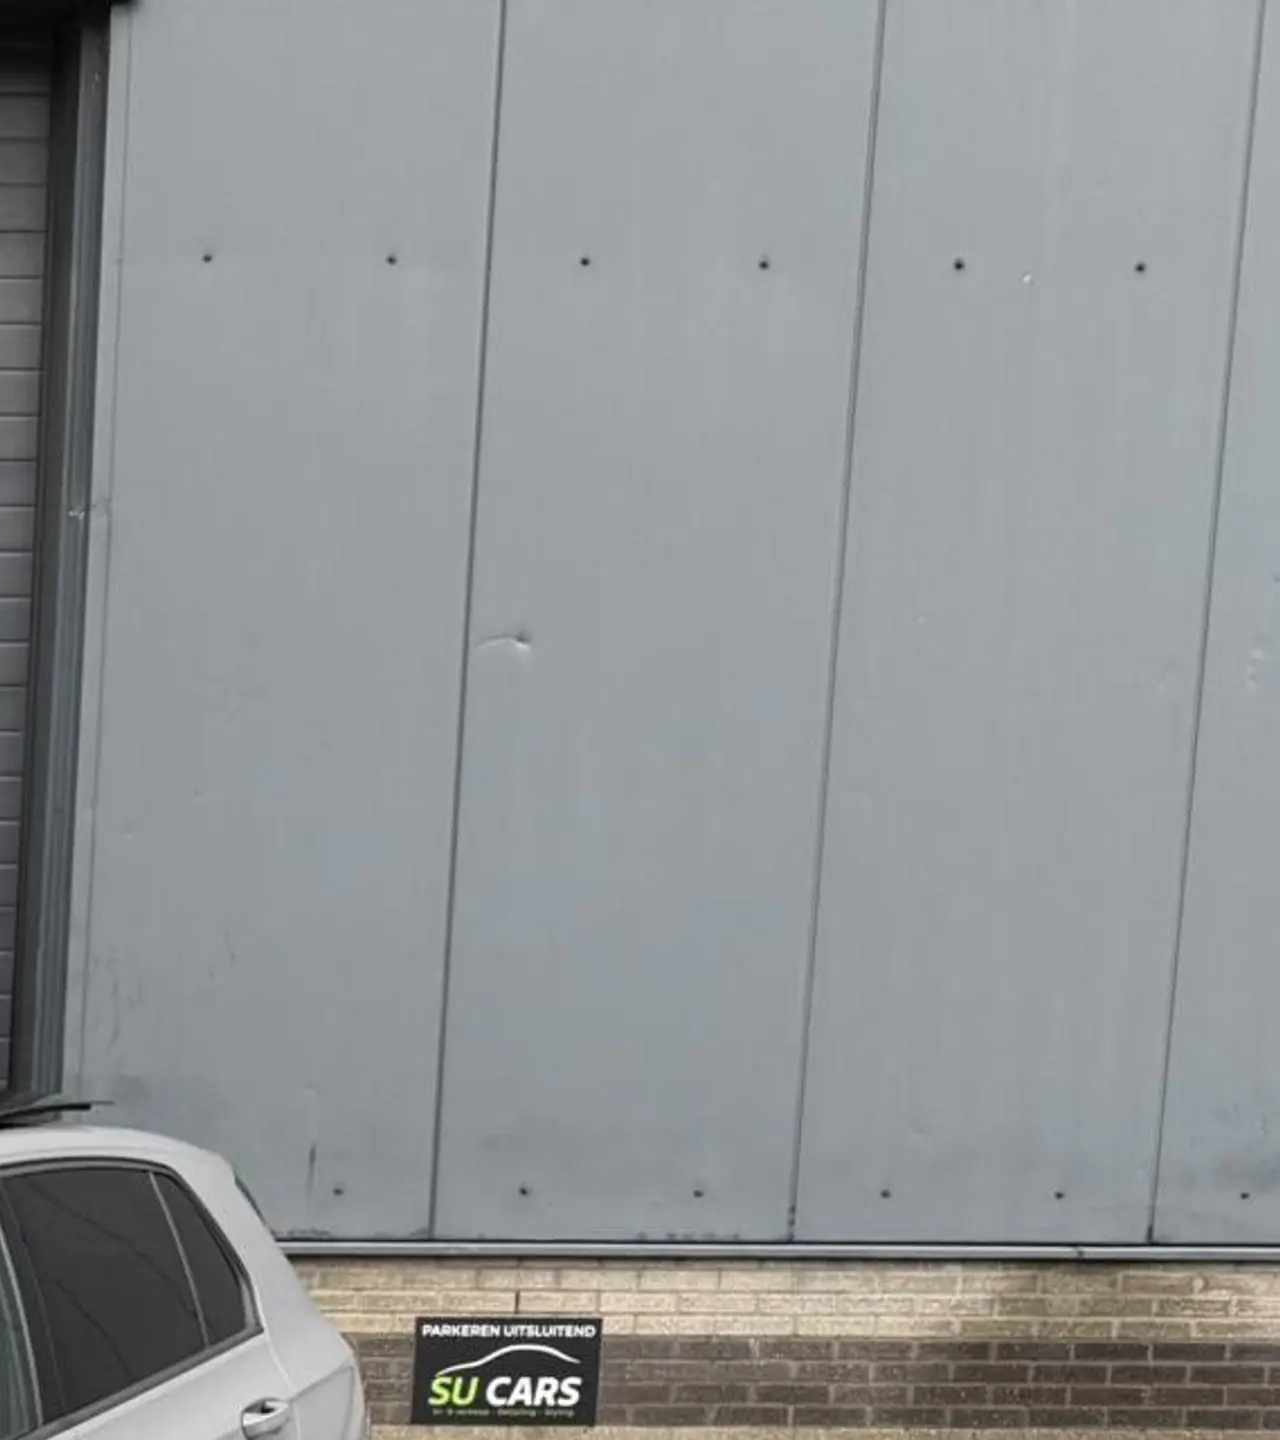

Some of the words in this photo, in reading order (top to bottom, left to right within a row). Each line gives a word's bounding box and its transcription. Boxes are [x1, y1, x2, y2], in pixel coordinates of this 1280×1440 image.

[421, 1323, 500, 1337] PARKEREN
[503, 1324, 597, 1338] UITSLUITEND
[428, 1375, 480, 1406] SU
[485, 1375, 583, 1407] CARS
